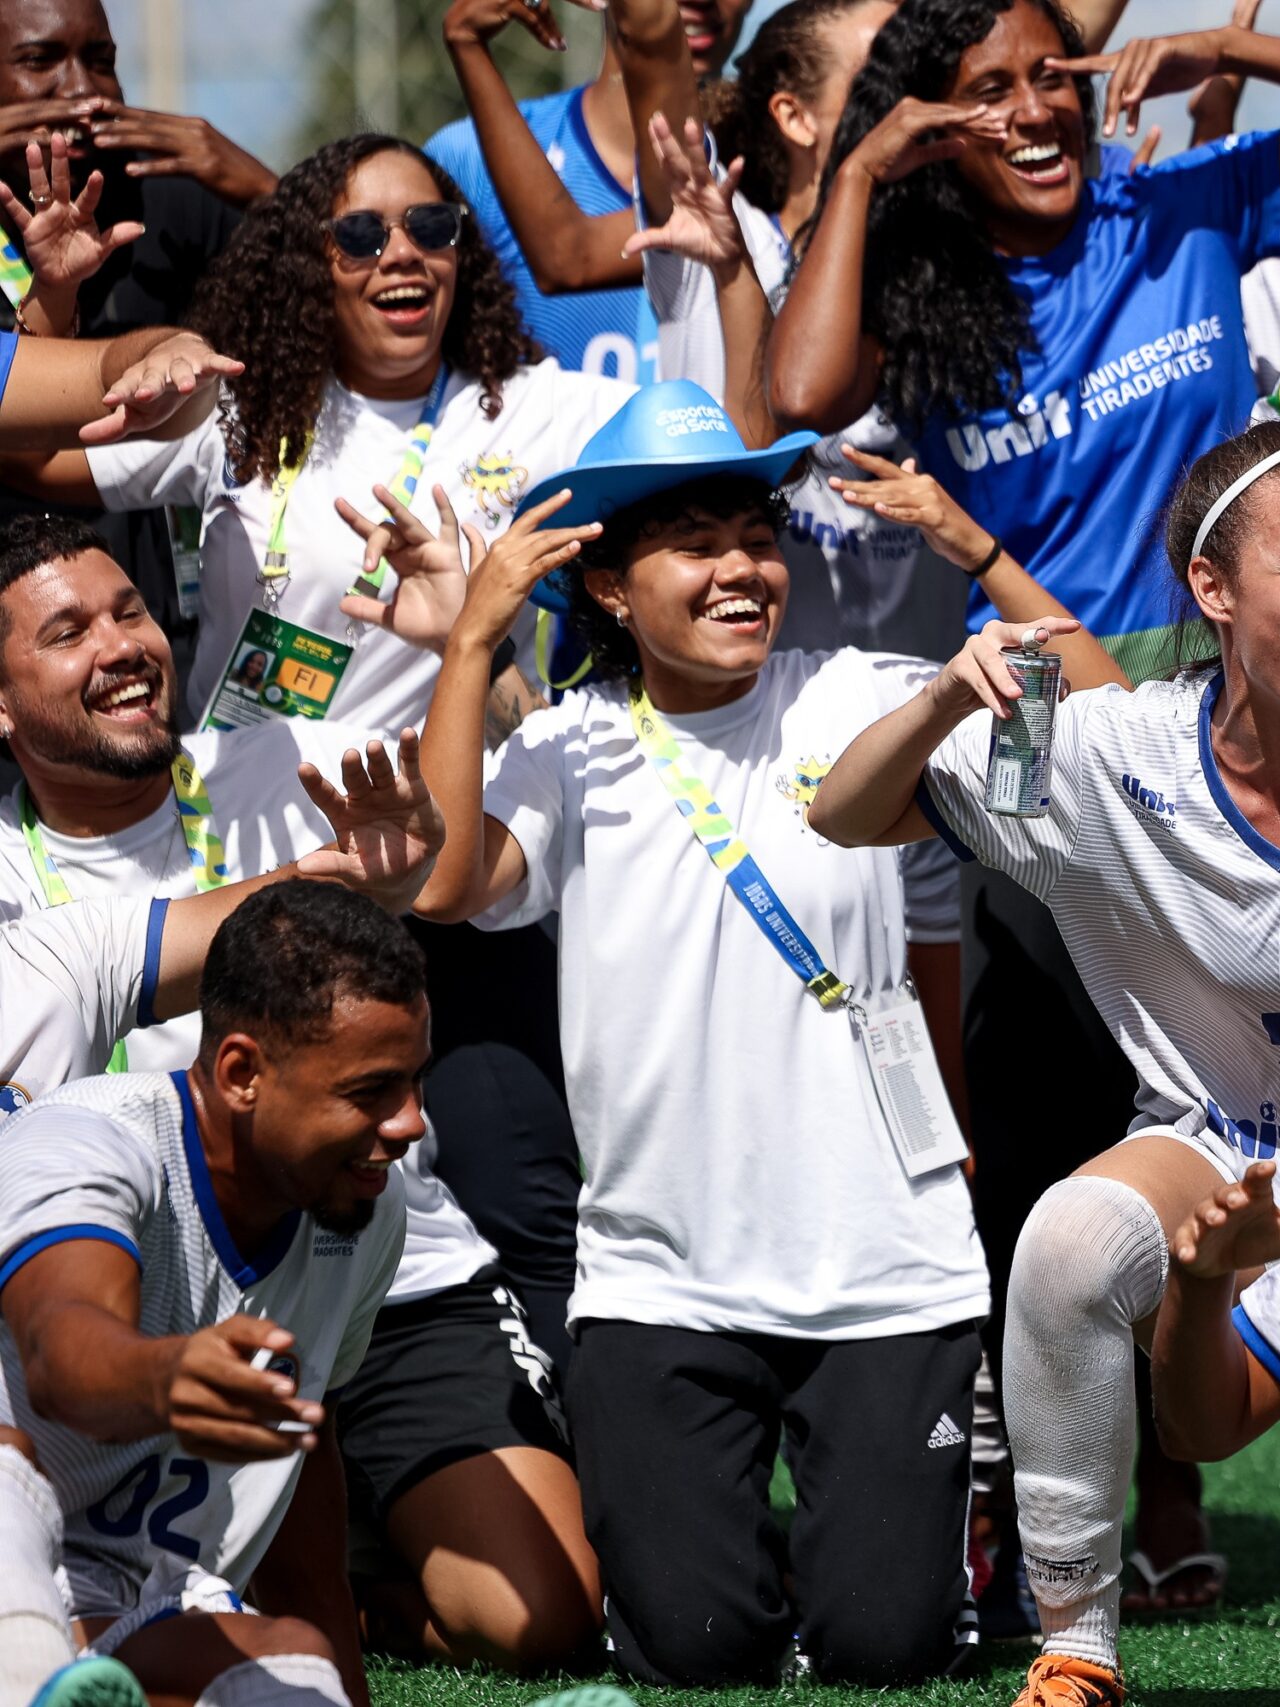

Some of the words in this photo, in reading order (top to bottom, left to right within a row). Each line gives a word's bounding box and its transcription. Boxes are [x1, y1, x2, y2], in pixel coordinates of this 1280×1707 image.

[1078, 315, 1224, 399] UNIVERSIDADE
[1081, 347, 1214, 422] TIRADENTES
[656, 405, 724, 427] Esportes
[686, 418, 728, 433] Sorte
[945, 391, 1072, 473] Unit
[743, 881, 774, 914] JOGOS
[927, 1431, 966, 1449] adidas
[86, 1454, 209, 1562] 02
